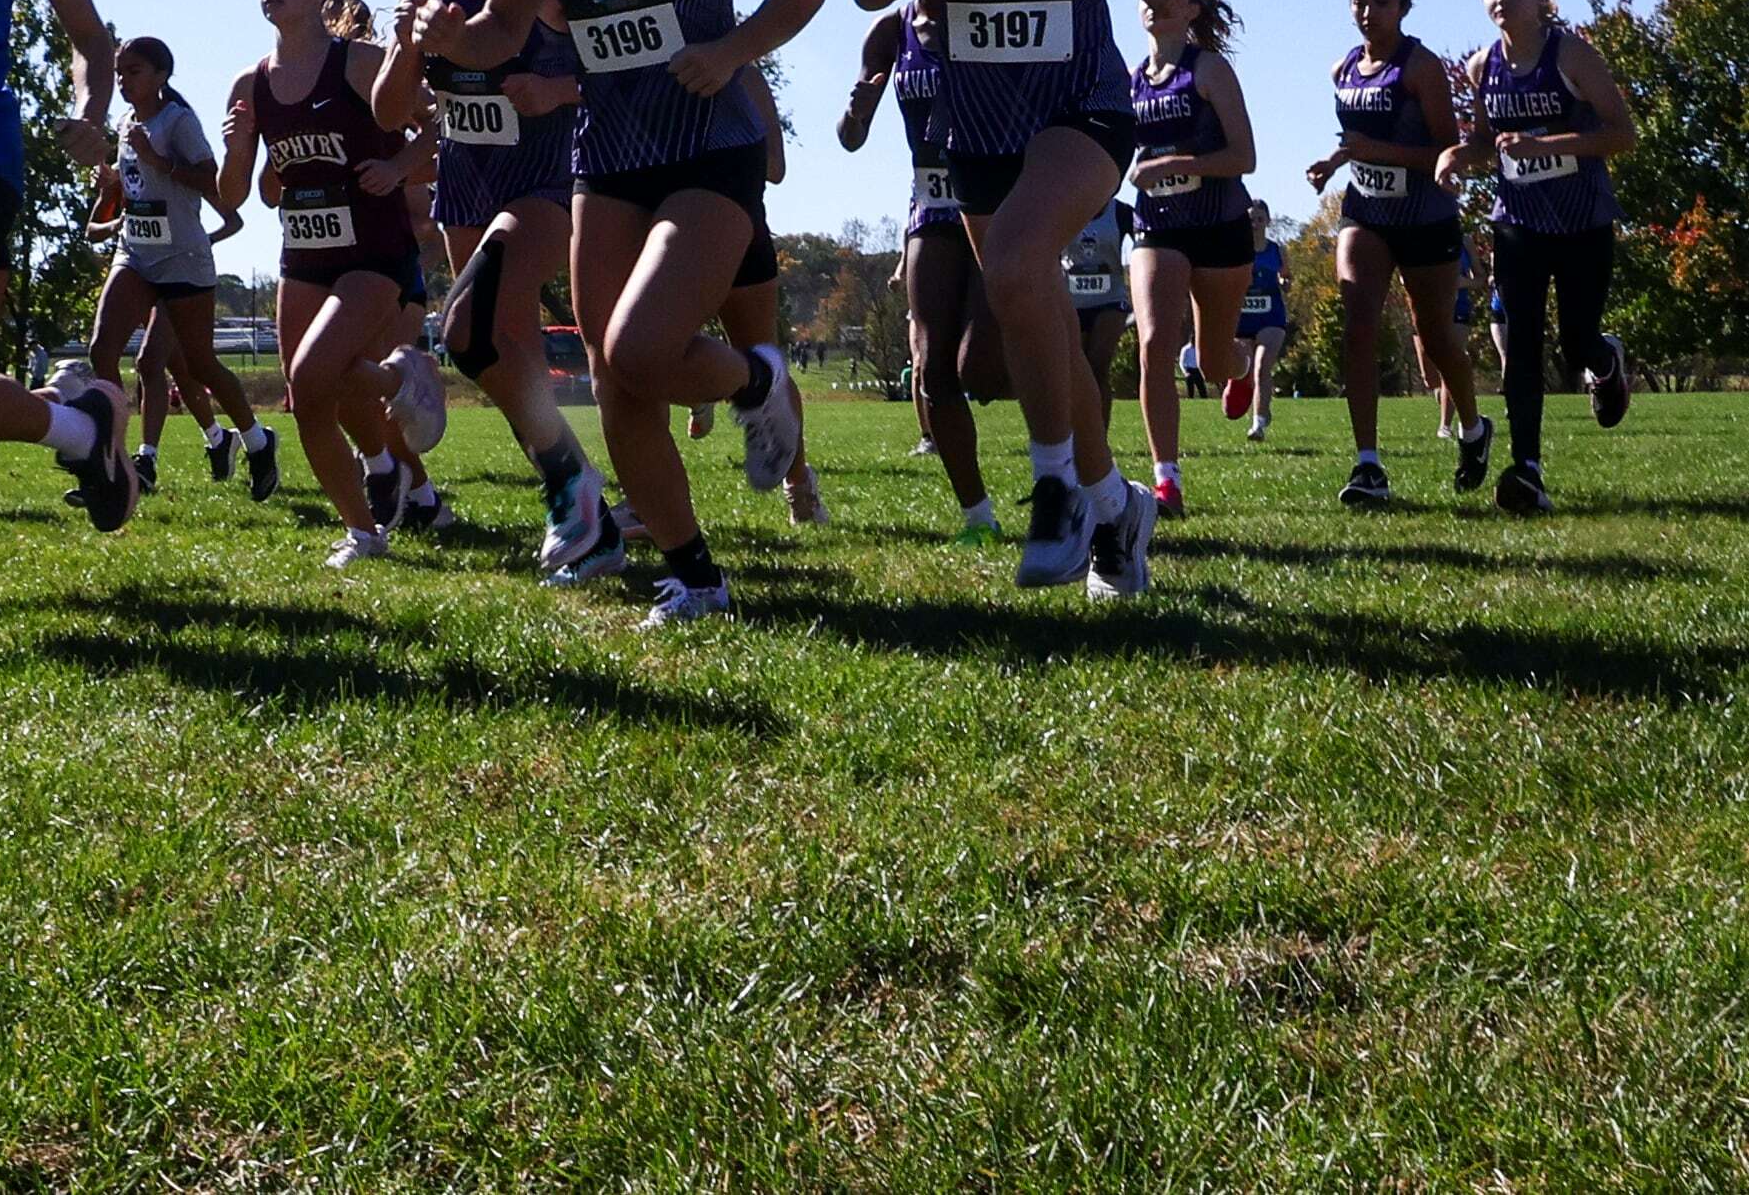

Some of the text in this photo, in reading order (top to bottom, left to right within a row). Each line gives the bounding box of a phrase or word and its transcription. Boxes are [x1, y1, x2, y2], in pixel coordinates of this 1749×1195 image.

[587, 16, 663, 60] 3196
[969, 10, 1047, 47] 3197
[446, 99, 502, 133] 3200
[1132, 94, 1191, 126] VALIERS
[1485, 93, 1562, 119] CAVALIERS
[1357, 166, 1395, 191] 3202
[129, 218, 161, 238] 3290
[288, 213, 341, 239] 3396
